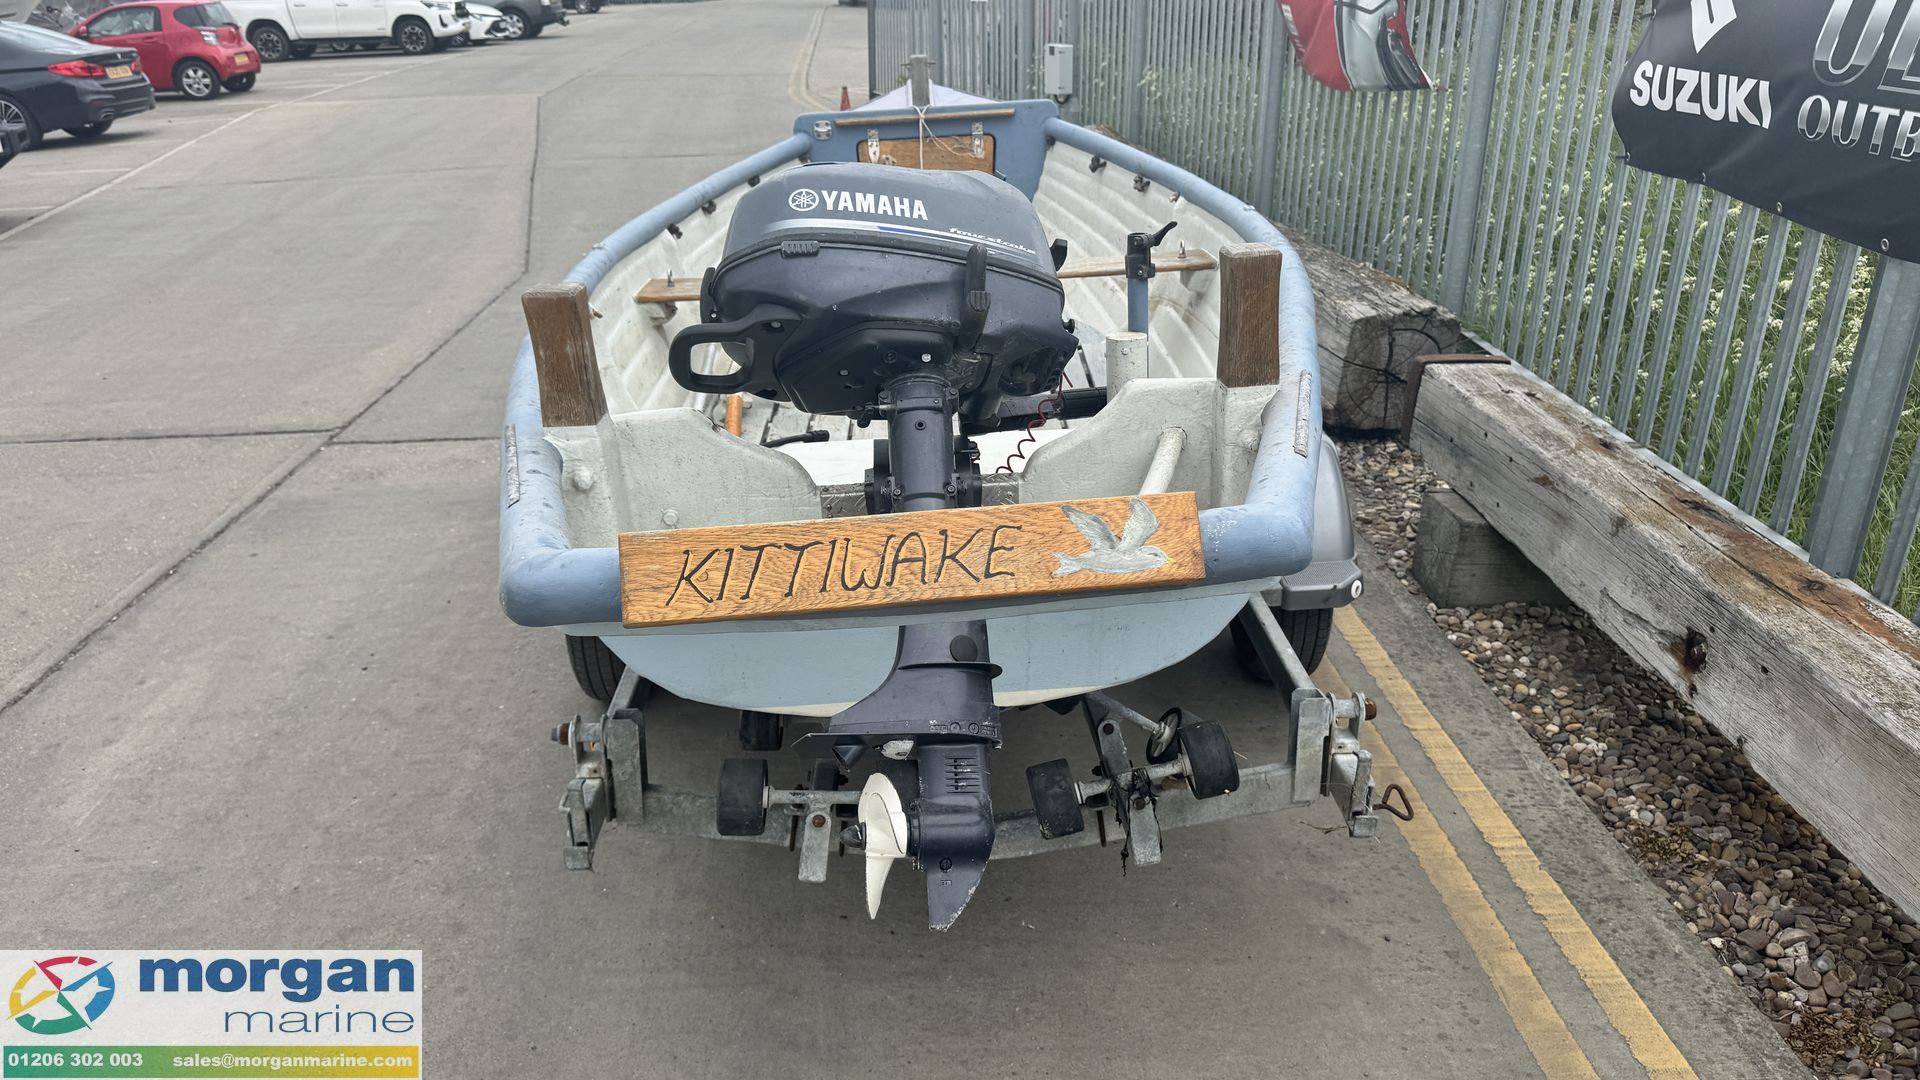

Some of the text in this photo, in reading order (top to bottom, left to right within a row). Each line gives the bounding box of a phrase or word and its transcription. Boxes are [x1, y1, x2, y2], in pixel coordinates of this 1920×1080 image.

[1629, 60, 1772, 129] SUZUKI
[821, 190, 929, 221] YAMAHA
[665, 524, 1023, 606] KITTIWAKE
